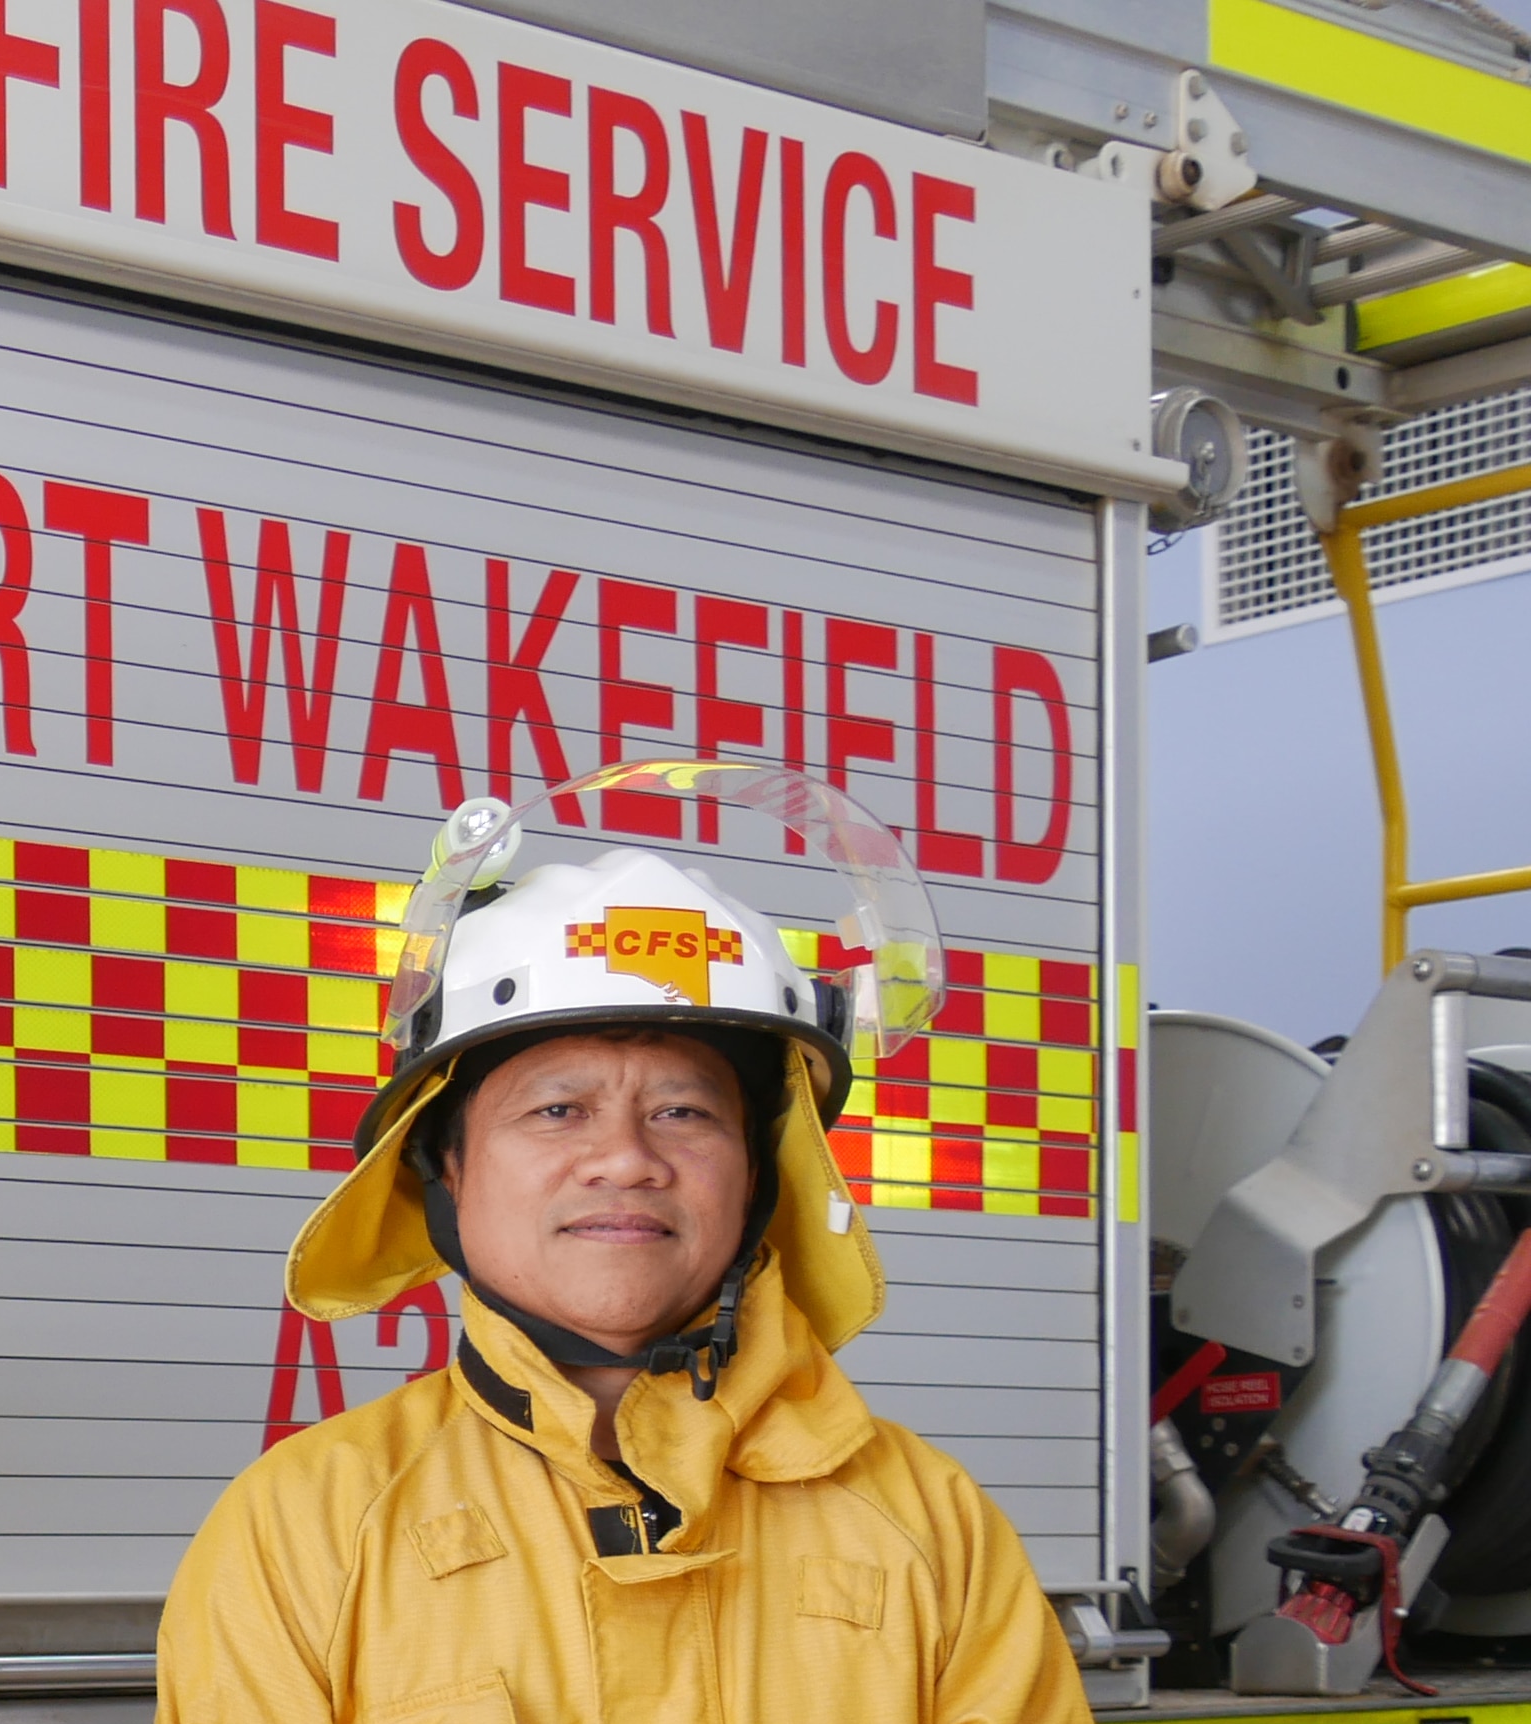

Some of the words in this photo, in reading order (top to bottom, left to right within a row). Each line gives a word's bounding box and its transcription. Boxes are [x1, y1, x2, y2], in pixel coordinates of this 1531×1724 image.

[394, 37, 979, 405] SERVICE
[196, 507, 1073, 885] WAKEFIELD
[613, 929, 699, 959] CFS
